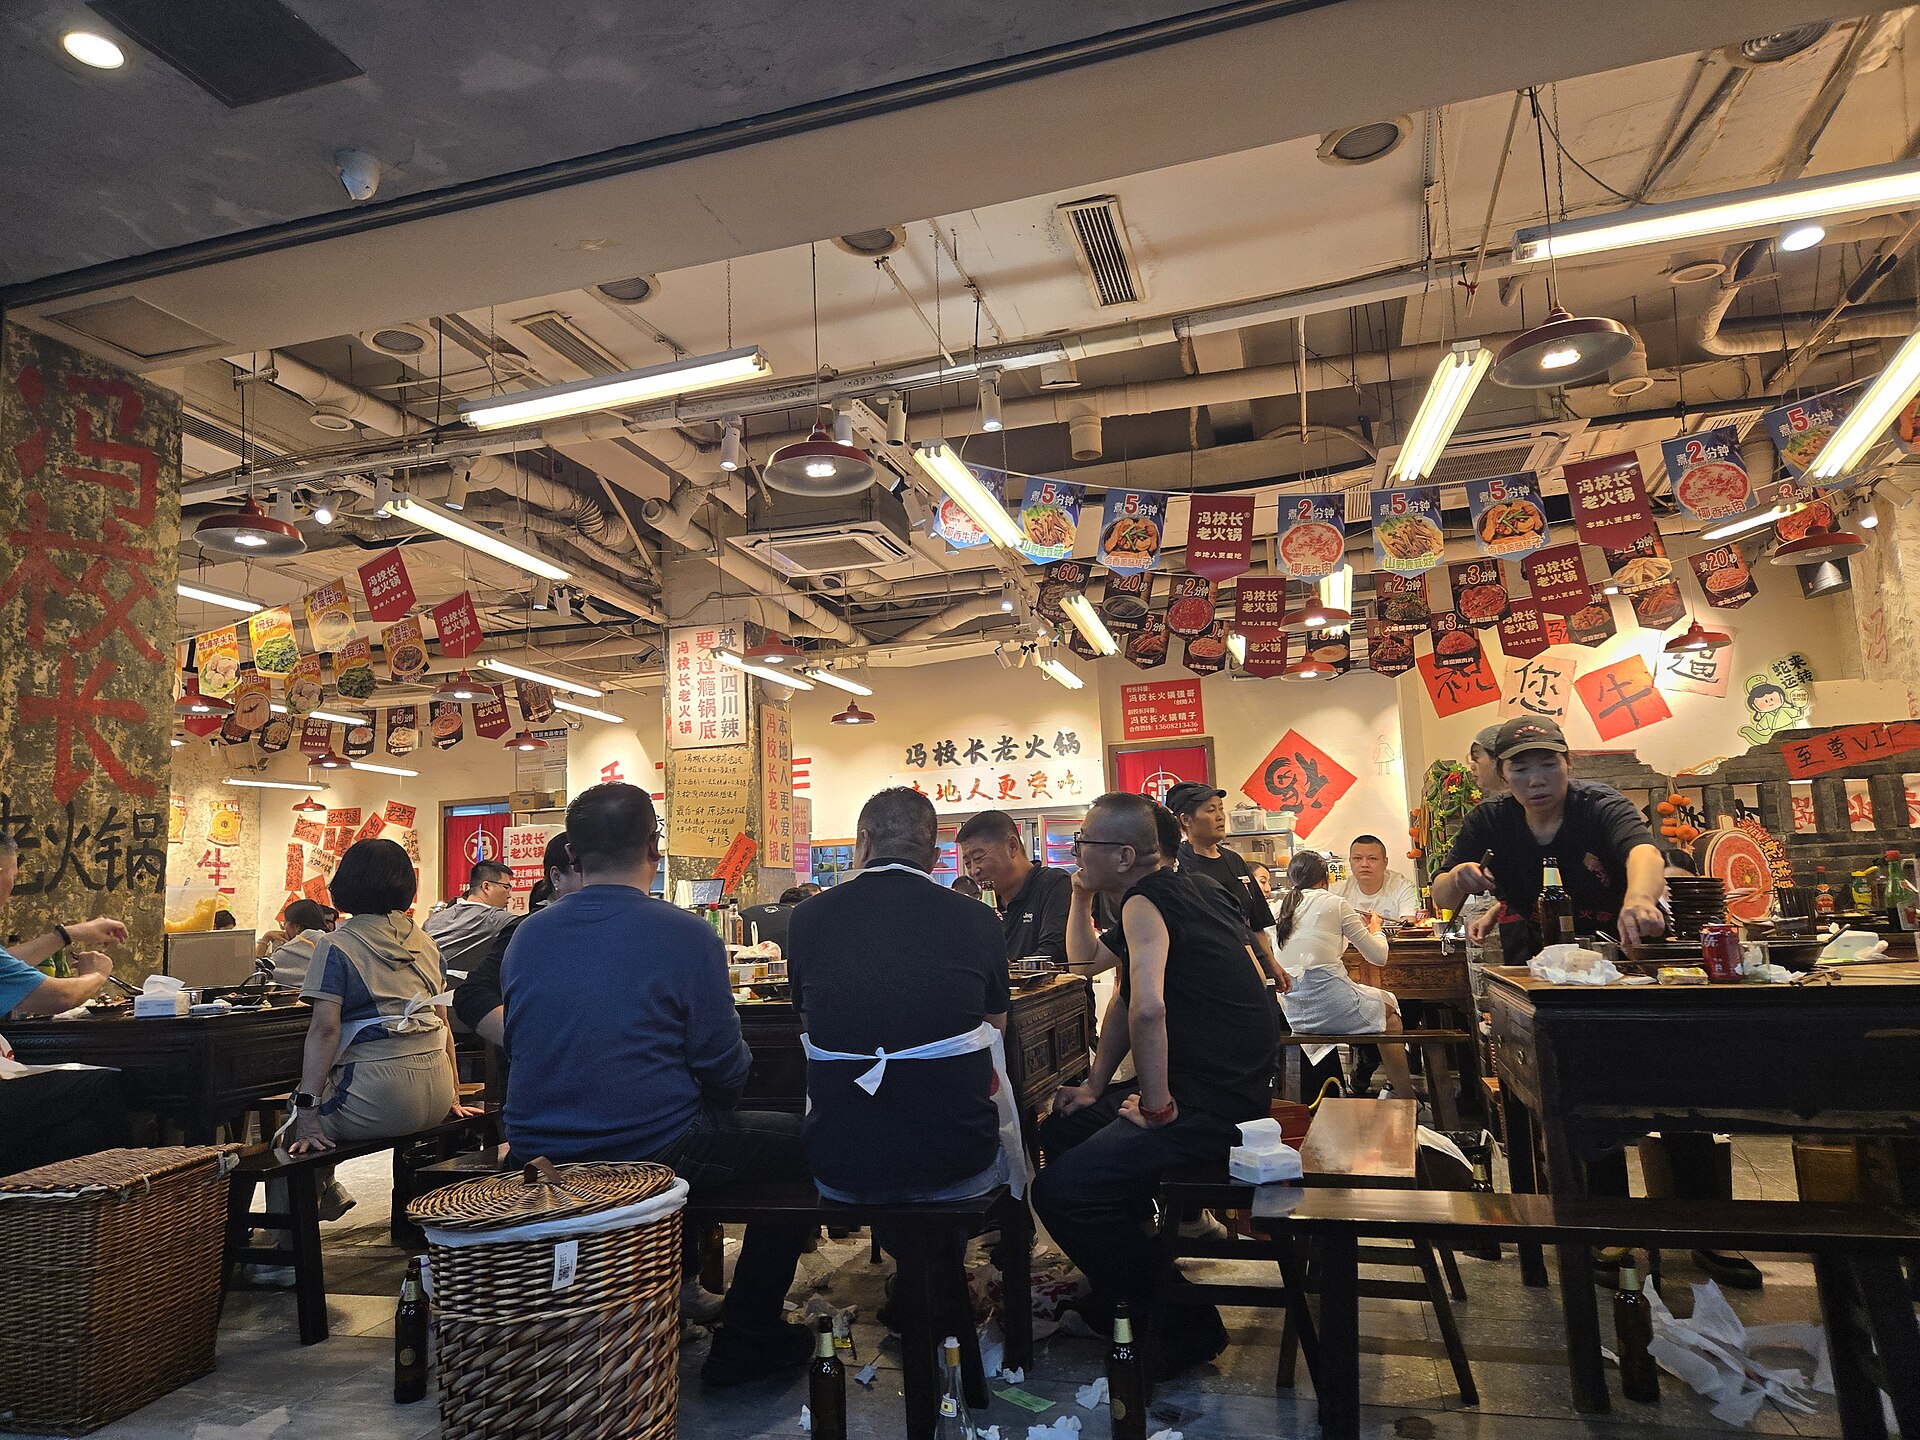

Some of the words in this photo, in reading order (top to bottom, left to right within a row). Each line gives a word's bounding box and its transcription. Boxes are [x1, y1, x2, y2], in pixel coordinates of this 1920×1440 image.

[1778, 407, 1834, 437] 煮5分钟
[1677, 441, 1730, 466] 煮2分钟
[1479, 480, 1530, 502] 煮5分钟
[1576, 474, 1632, 494] 冯校长
[1030, 483, 1075, 506] 煮5分钟
[1380, 493, 1431, 516] 煮5分钟
[1581, 489, 1636, 510] 老火锅
[1113, 494, 1158, 516] 煮5分钟
[1288, 499, 1335, 520] 煮2分钟
[1197, 512, 1244, 527] 冯校长
[1585, 513, 1642, 529] 本地人更爱吃
[1196, 527, 1243, 542] 老火锅
[1194, 550, 1242, 560] 本地人更爱吃
[367, 564, 398, 587] 冯校长
[1458, 565, 1497, 585] 煮3分钟
[1533, 559, 1575, 576] 冯校长
[1, 363, 165, 804] 冯校长
[371, 575, 402, 598] 老火锅
[1175, 578, 1210, 597] 煮2分钟
[1384, 575, 1422, 593] 煮2分钟
[1536, 571, 1578, 588] 老火锅
[1242, 590, 1278, 602] 冯校长
[440, 607, 468, 626] 冯校长
[1242, 602, 1278, 613] 老火锅
[254, 617, 280, 633] 豌豆
[443, 617, 471, 635] 老火锅
[1503, 620, 1539, 635] 老火锅
[1249, 643, 1281, 653] 老火锅
[676, 640, 692, 734] 冯校长老火锅
[695, 630, 717, 740] 要过瘾锅底
[718, 628, 740, 739] 就四川辣
[1509, 661, 1562, 716] 您
[1597, 673, 1652, 729] 牛
[477, 704, 503, 718] 老火锅
[905, 730, 1081, 768] 冯校长老火锅
[766, 713, 779, 862] 冯校长老火锅
[778, 716, 790, 863] 本地人更爱吃
[510, 832, 545, 845] 冯校长
[510, 847, 544, 859] 老火锅
[511, 869, 544, 878] 要过瘾锅
